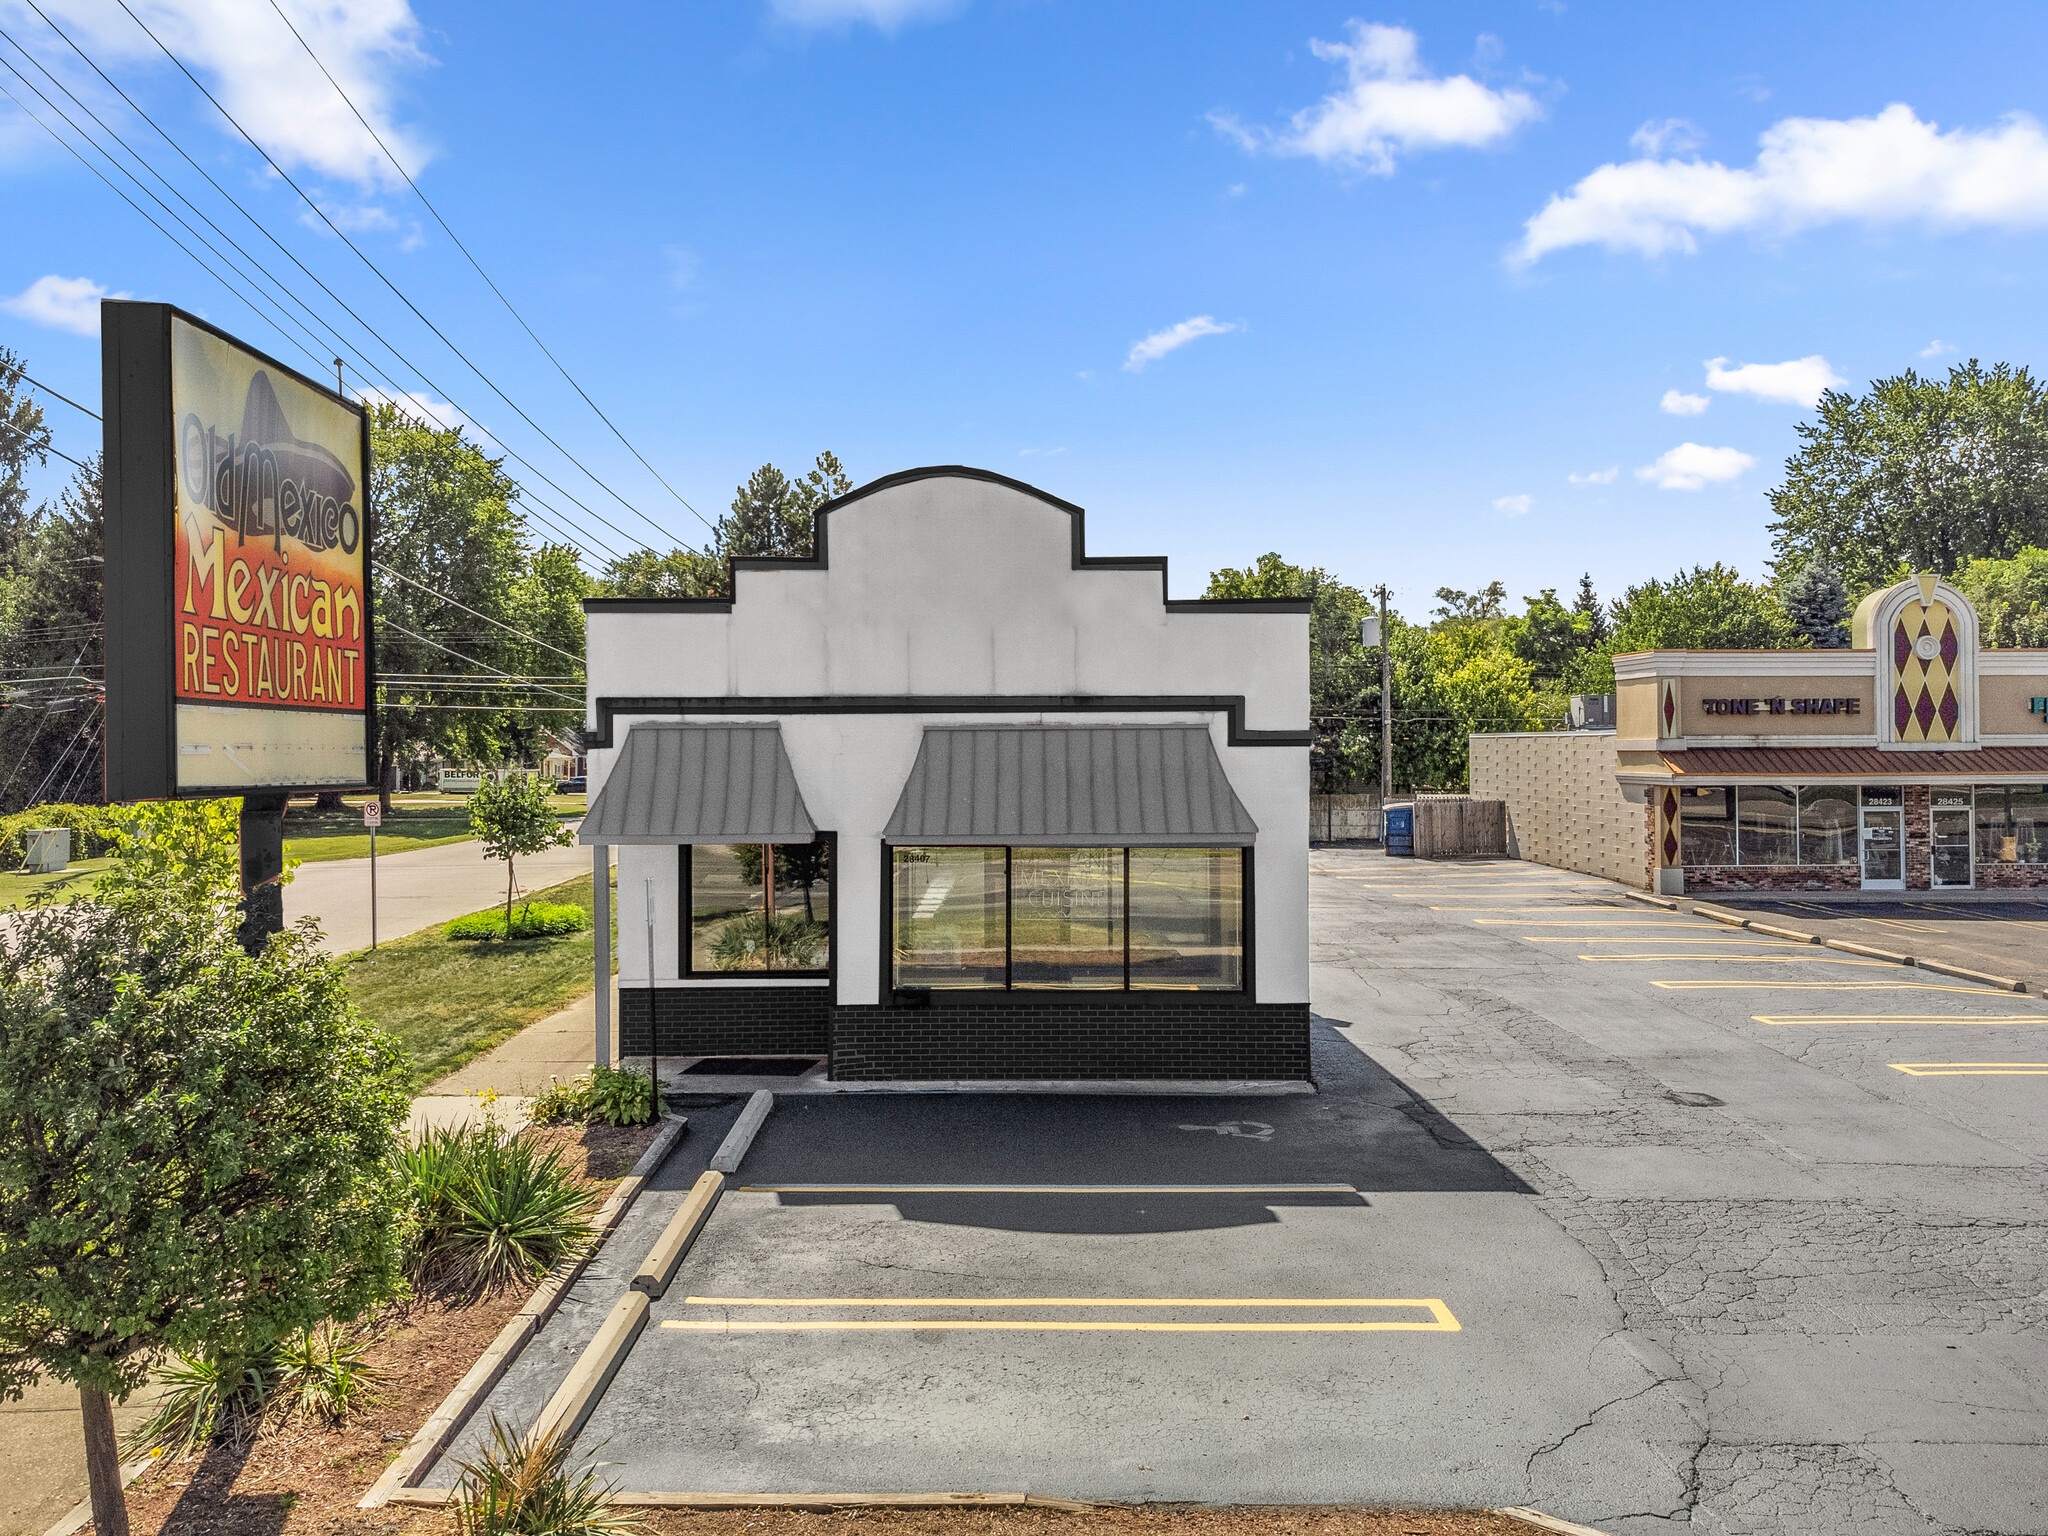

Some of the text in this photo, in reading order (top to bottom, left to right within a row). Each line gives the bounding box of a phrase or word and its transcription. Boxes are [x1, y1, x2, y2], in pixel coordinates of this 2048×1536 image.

[182, 412, 360, 557] Old Mexico
[182, 510, 362, 643] Mexican
[182, 620, 361, 706] RESTAURANT
[1702, 698, 1760, 715] TONE
[1791, 698, 1861, 715] SHAPE
[444, 770, 480, 779] BELFOR
[1868, 798, 1893, 806] 28423
[1937, 798, 1964, 806] 28425
[903, 854, 931, 864] 28407
